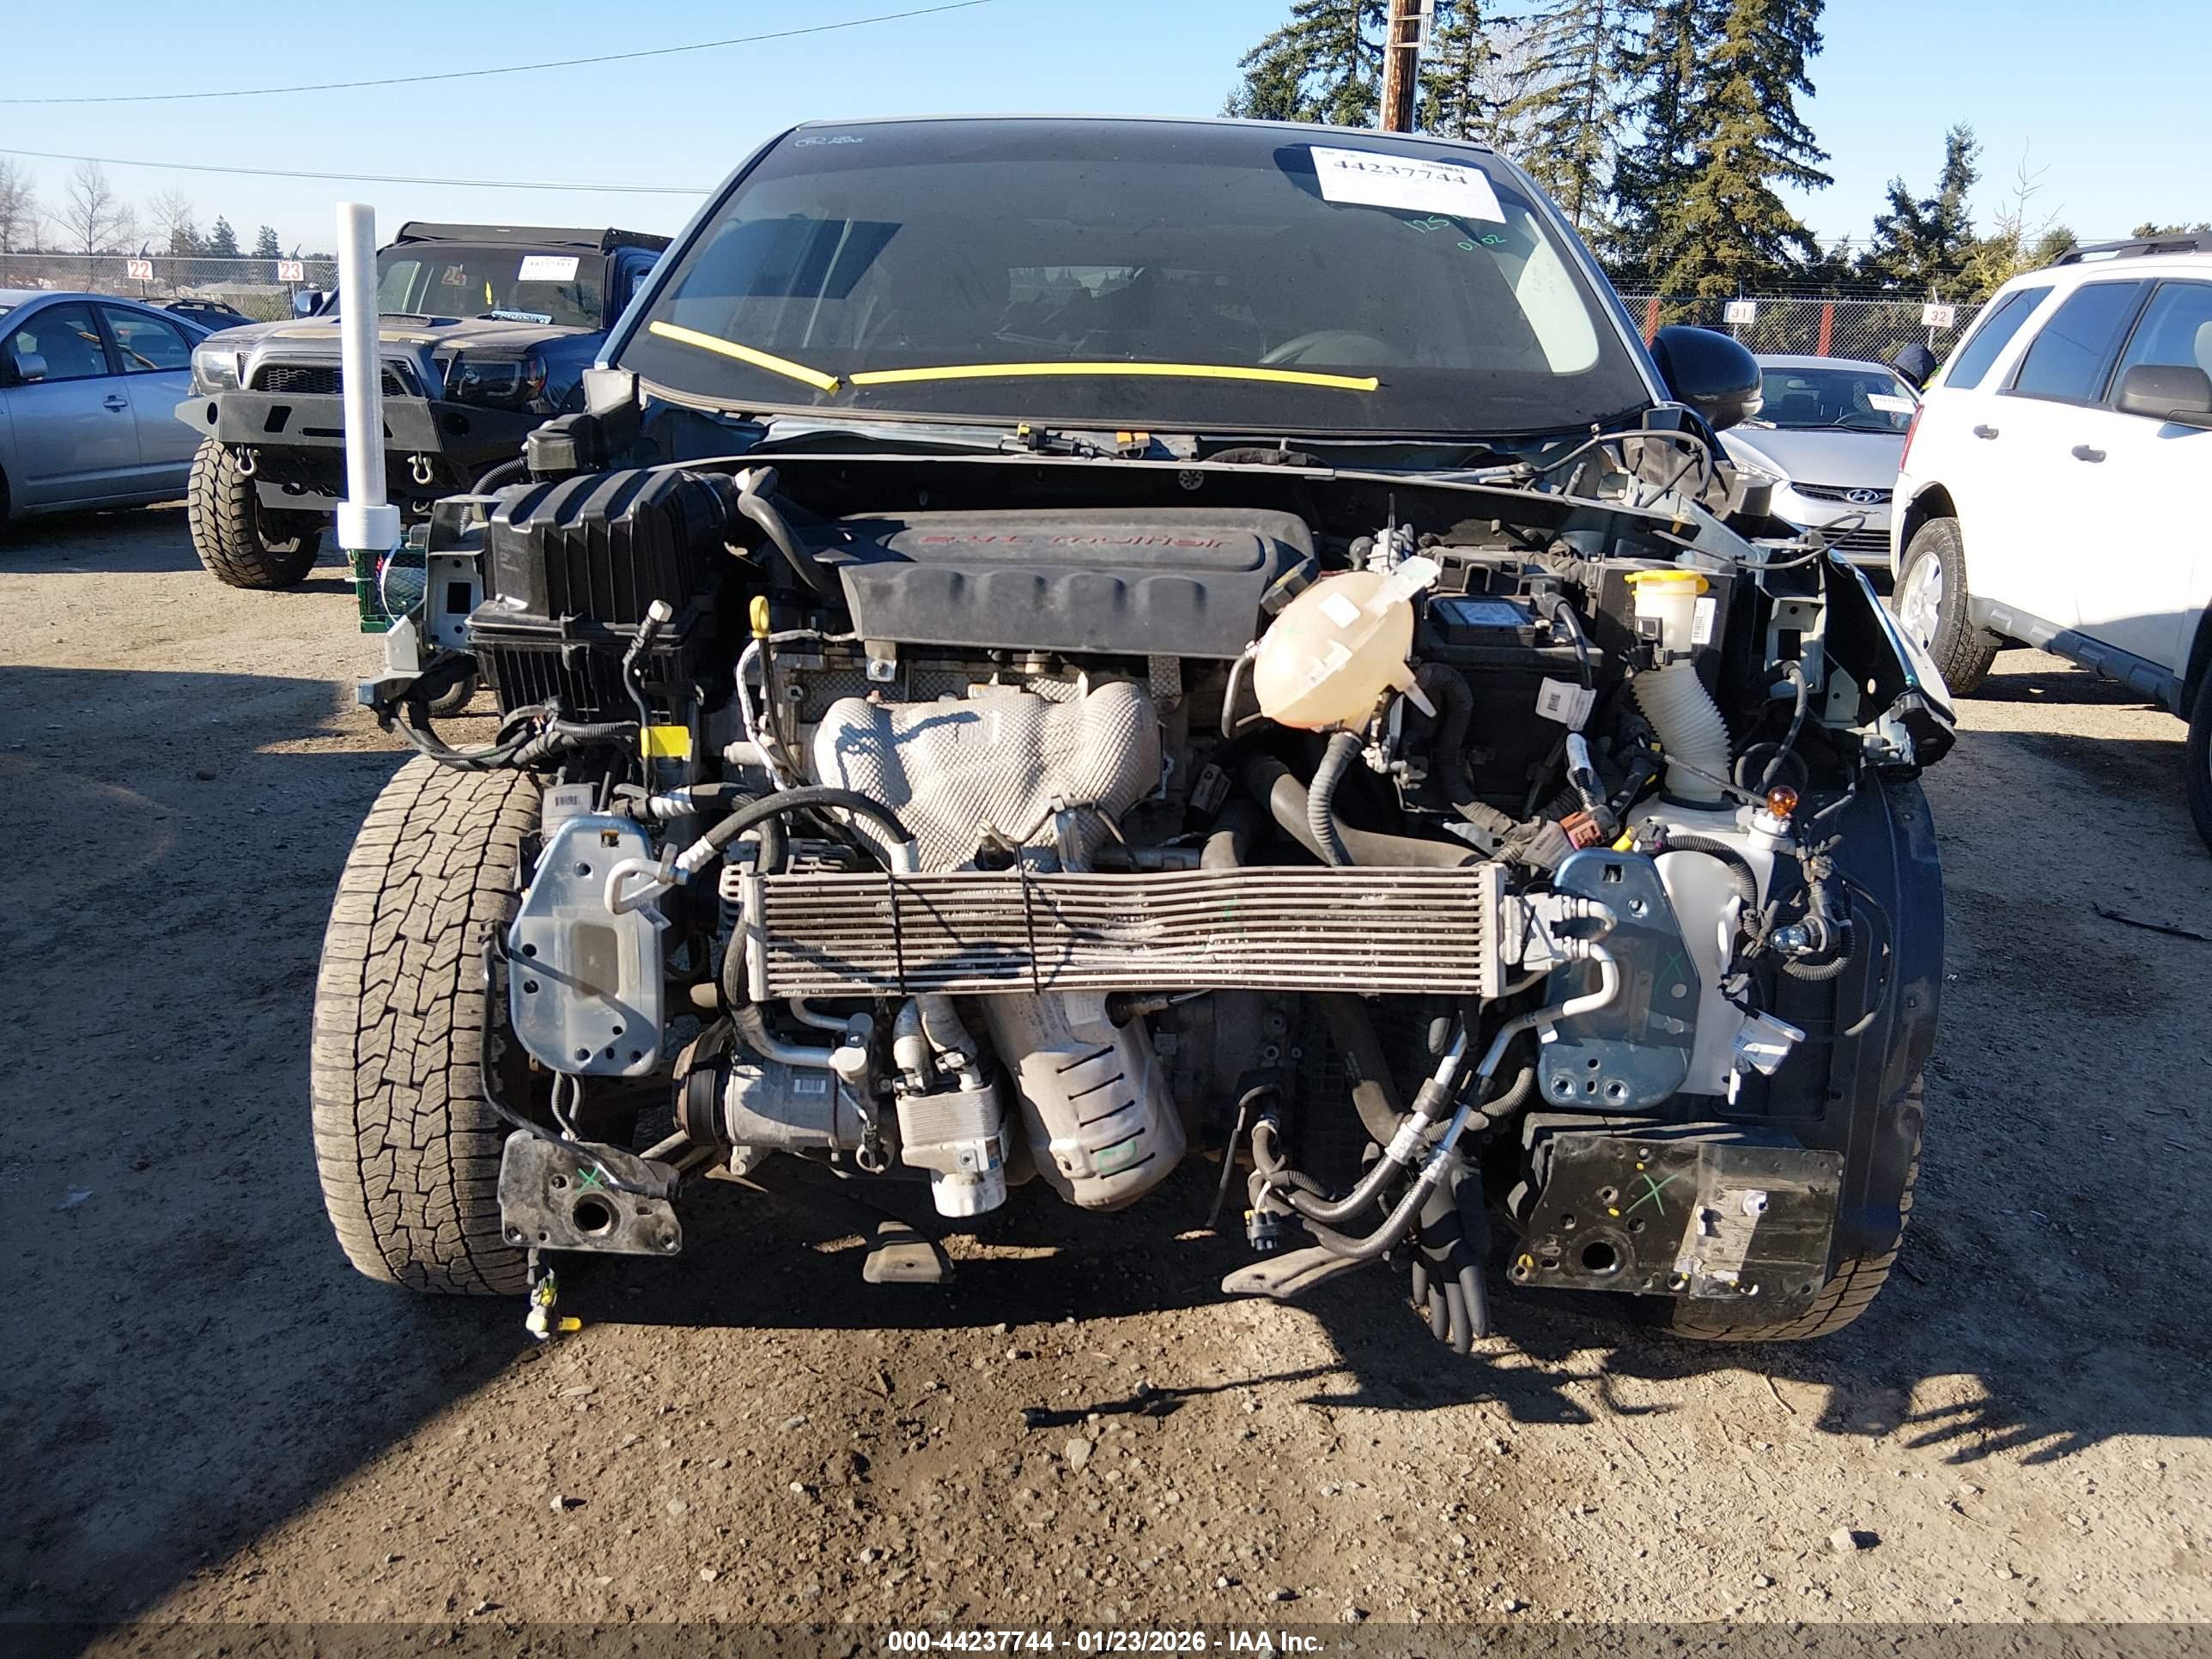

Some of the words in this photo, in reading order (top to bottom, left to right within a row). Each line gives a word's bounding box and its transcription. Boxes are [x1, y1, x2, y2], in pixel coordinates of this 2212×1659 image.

[1333, 160, 1468, 185] 44237744
[130, 261, 150, 278] 22
[281, 263, 301, 279] 23
[442, 267, 465, 283] 24
[1731, 307, 1747, 319] 31
[1930, 310, 1947, 322] 32
